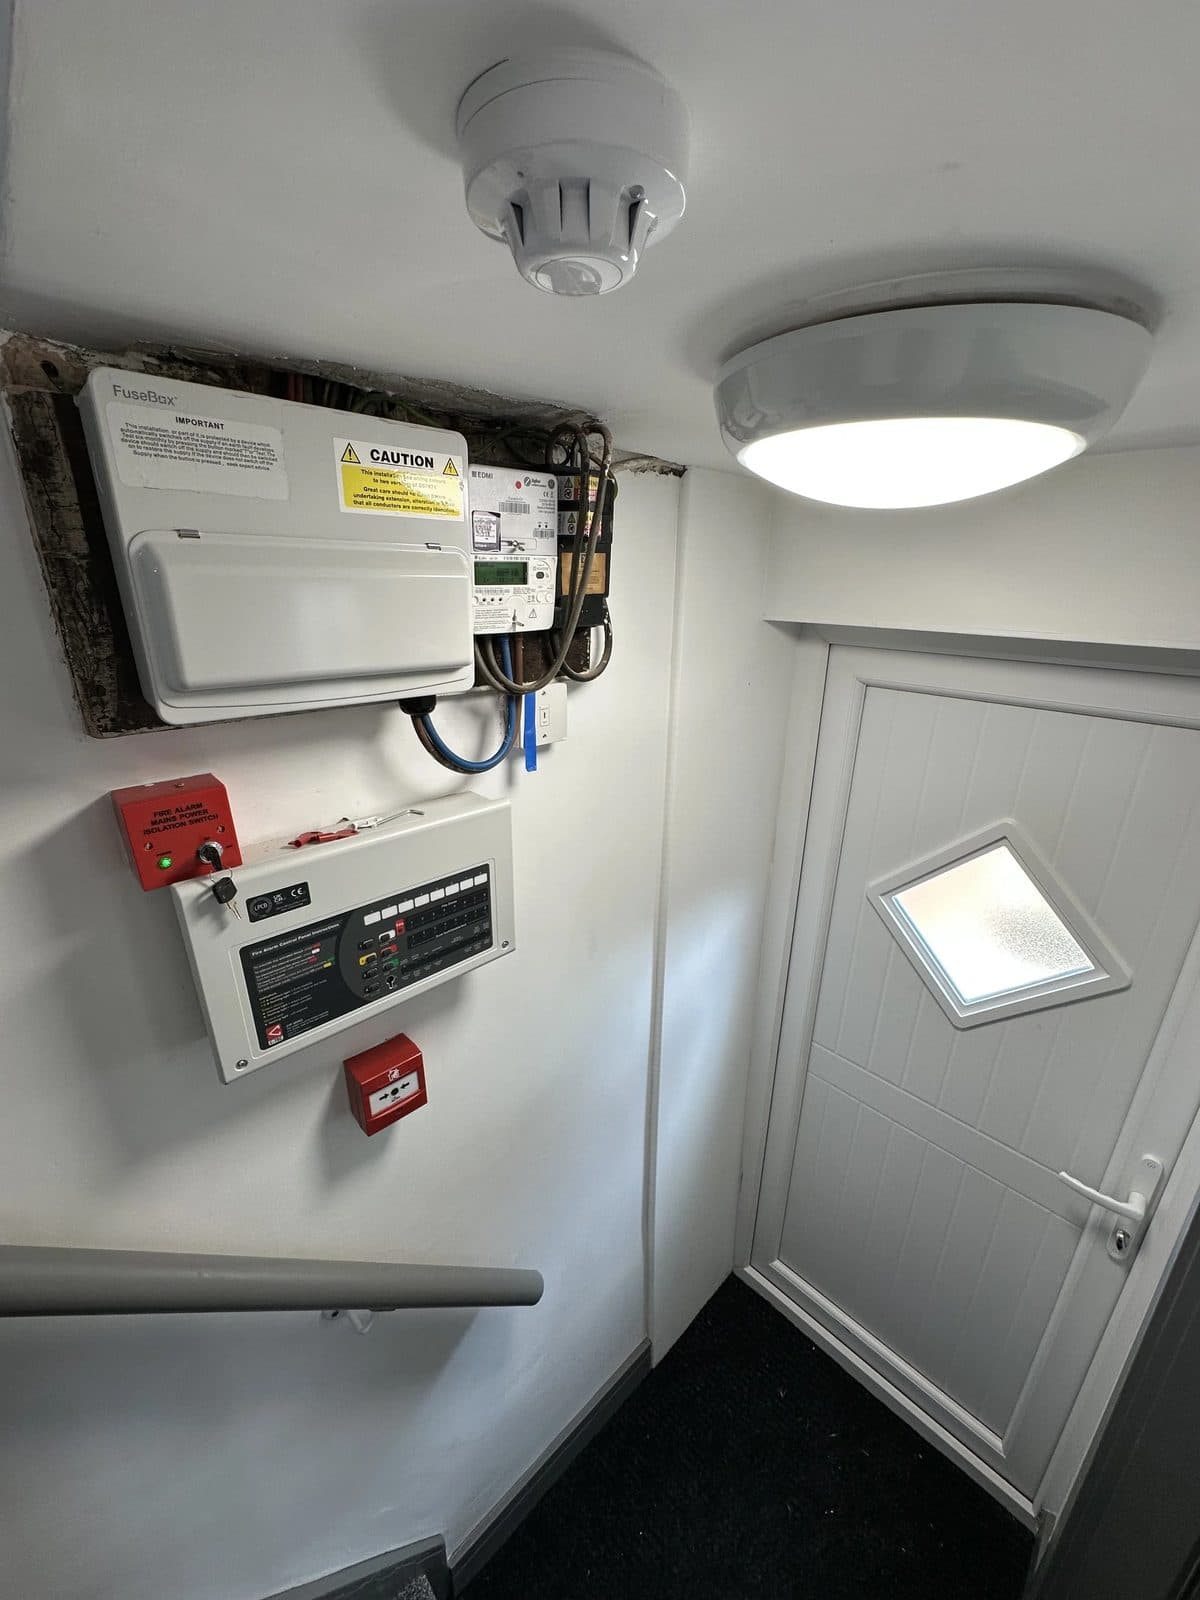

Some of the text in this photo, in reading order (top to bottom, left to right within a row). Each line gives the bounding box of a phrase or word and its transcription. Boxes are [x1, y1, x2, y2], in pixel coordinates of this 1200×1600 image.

[112, 384, 176, 407] FuseBox
[175, 416, 225, 430] IMPORTANT
[370, 449, 434, 468] CAUTION
[478, 471, 493, 480] EDMI
[151, 809, 208, 826] MAINS POWER
[153, 802, 202, 817] FIRE ALARM
[143, 814, 218, 835] ISOLATION SWITCH
